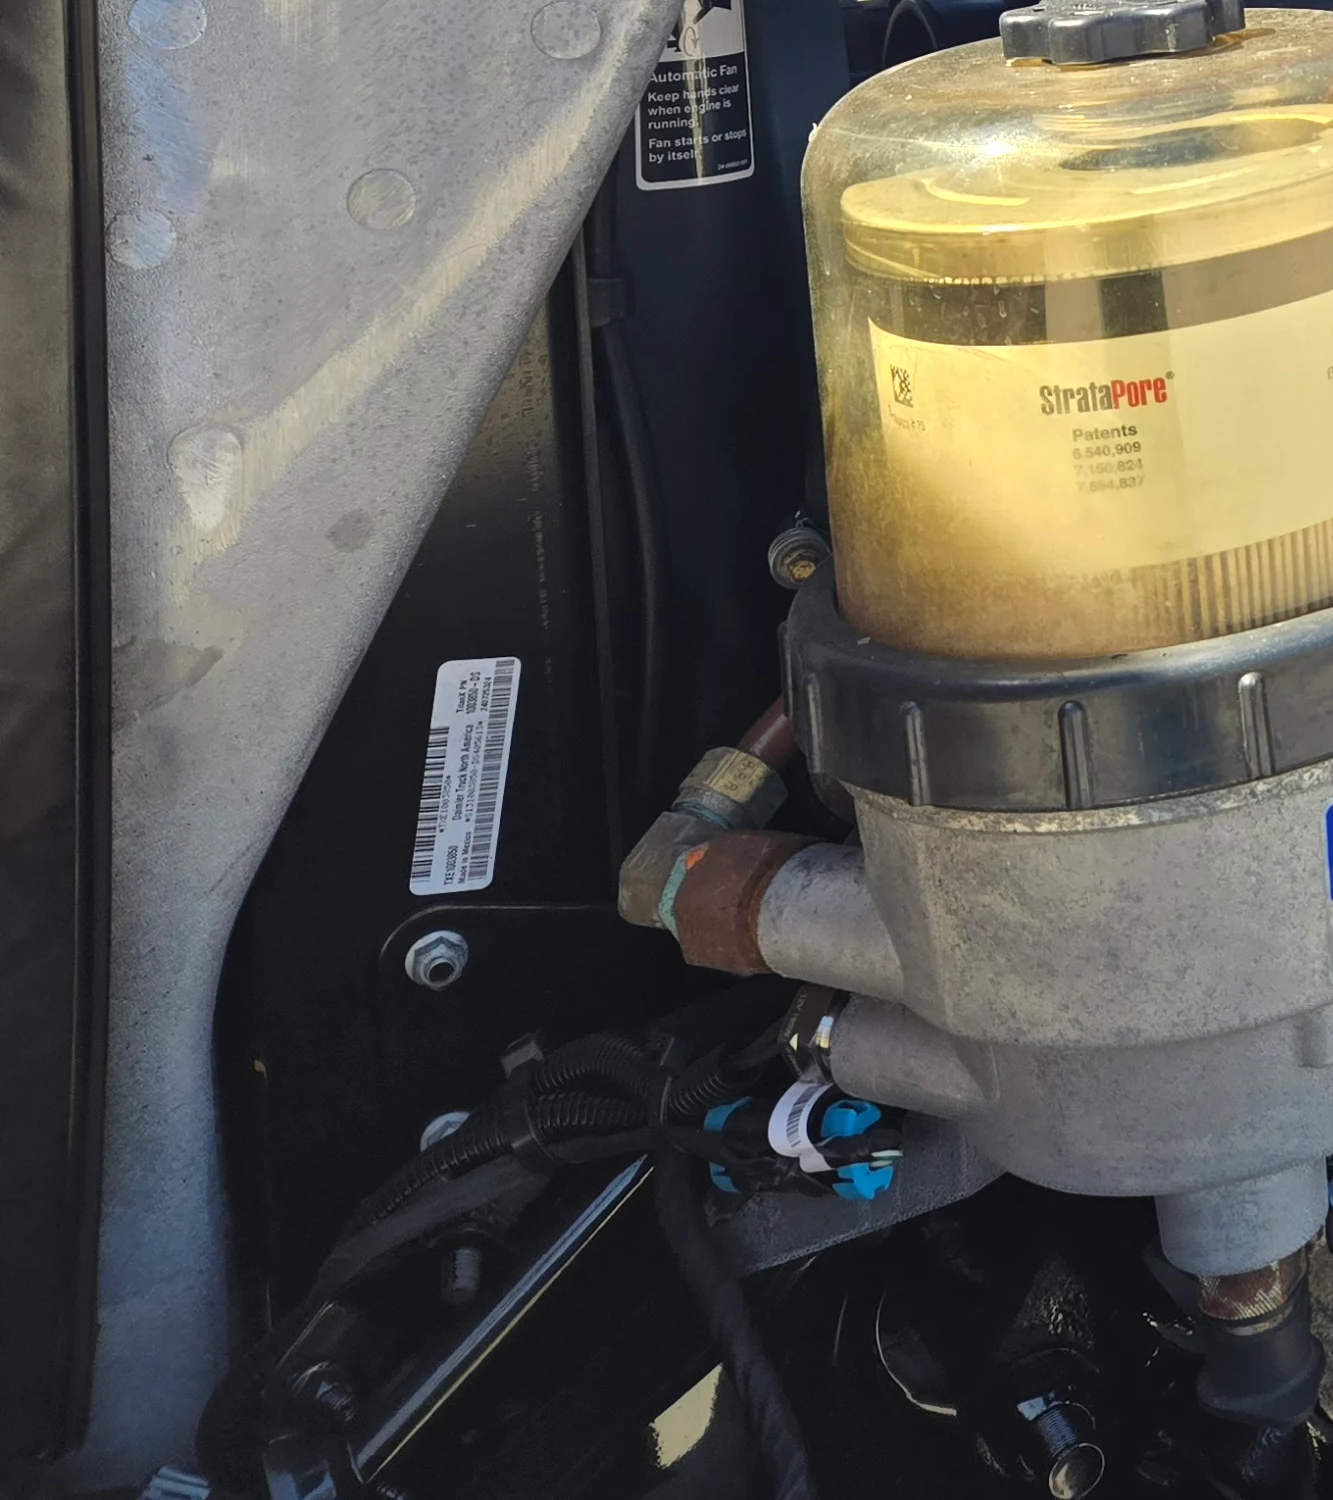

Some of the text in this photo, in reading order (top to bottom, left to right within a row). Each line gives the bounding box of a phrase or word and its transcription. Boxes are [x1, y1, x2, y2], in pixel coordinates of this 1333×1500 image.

[649, 64, 738, 83] Automatic Fan
[647, 83, 740, 103] Keep hands clear
[647, 97, 732, 116] when engine is
[647, 117, 699, 131] running.
[648, 128, 748, 149] Fan starts or stops
[648, 152, 664, 164] by
[1071, 423, 1138, 441] Patents
[456, 690, 466, 713] TitanX
[452, 724, 474, 821] Daimler Truck North America
[461, 831, 472, 859] Mexico
[458, 868, 467, 884] Made
